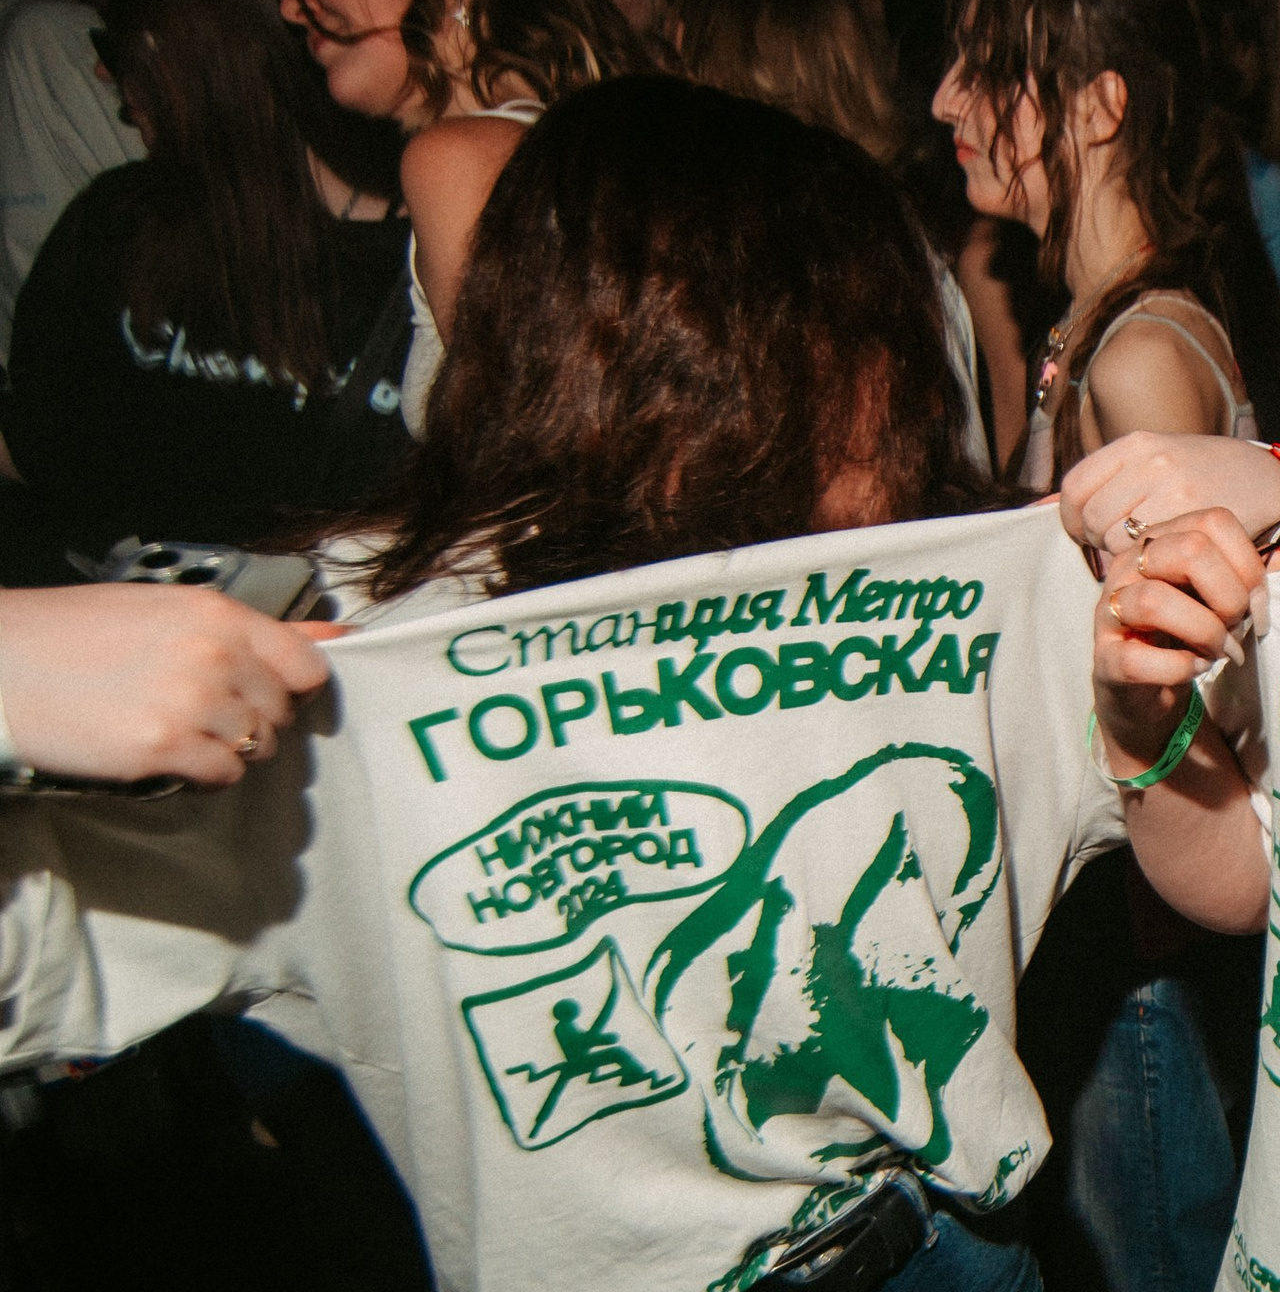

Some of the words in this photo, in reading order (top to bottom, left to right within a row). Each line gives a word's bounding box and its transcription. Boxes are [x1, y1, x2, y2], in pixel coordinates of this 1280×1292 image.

[447, 589, 787, 678] Станция
[791, 569, 985, 630] Метро
[409, 632, 1001, 783] ГОРЬКОВСКАЯ
[467, 827, 705, 924] НОВГОРОД
[474, 792, 671, 877] НИЖНИЙ
